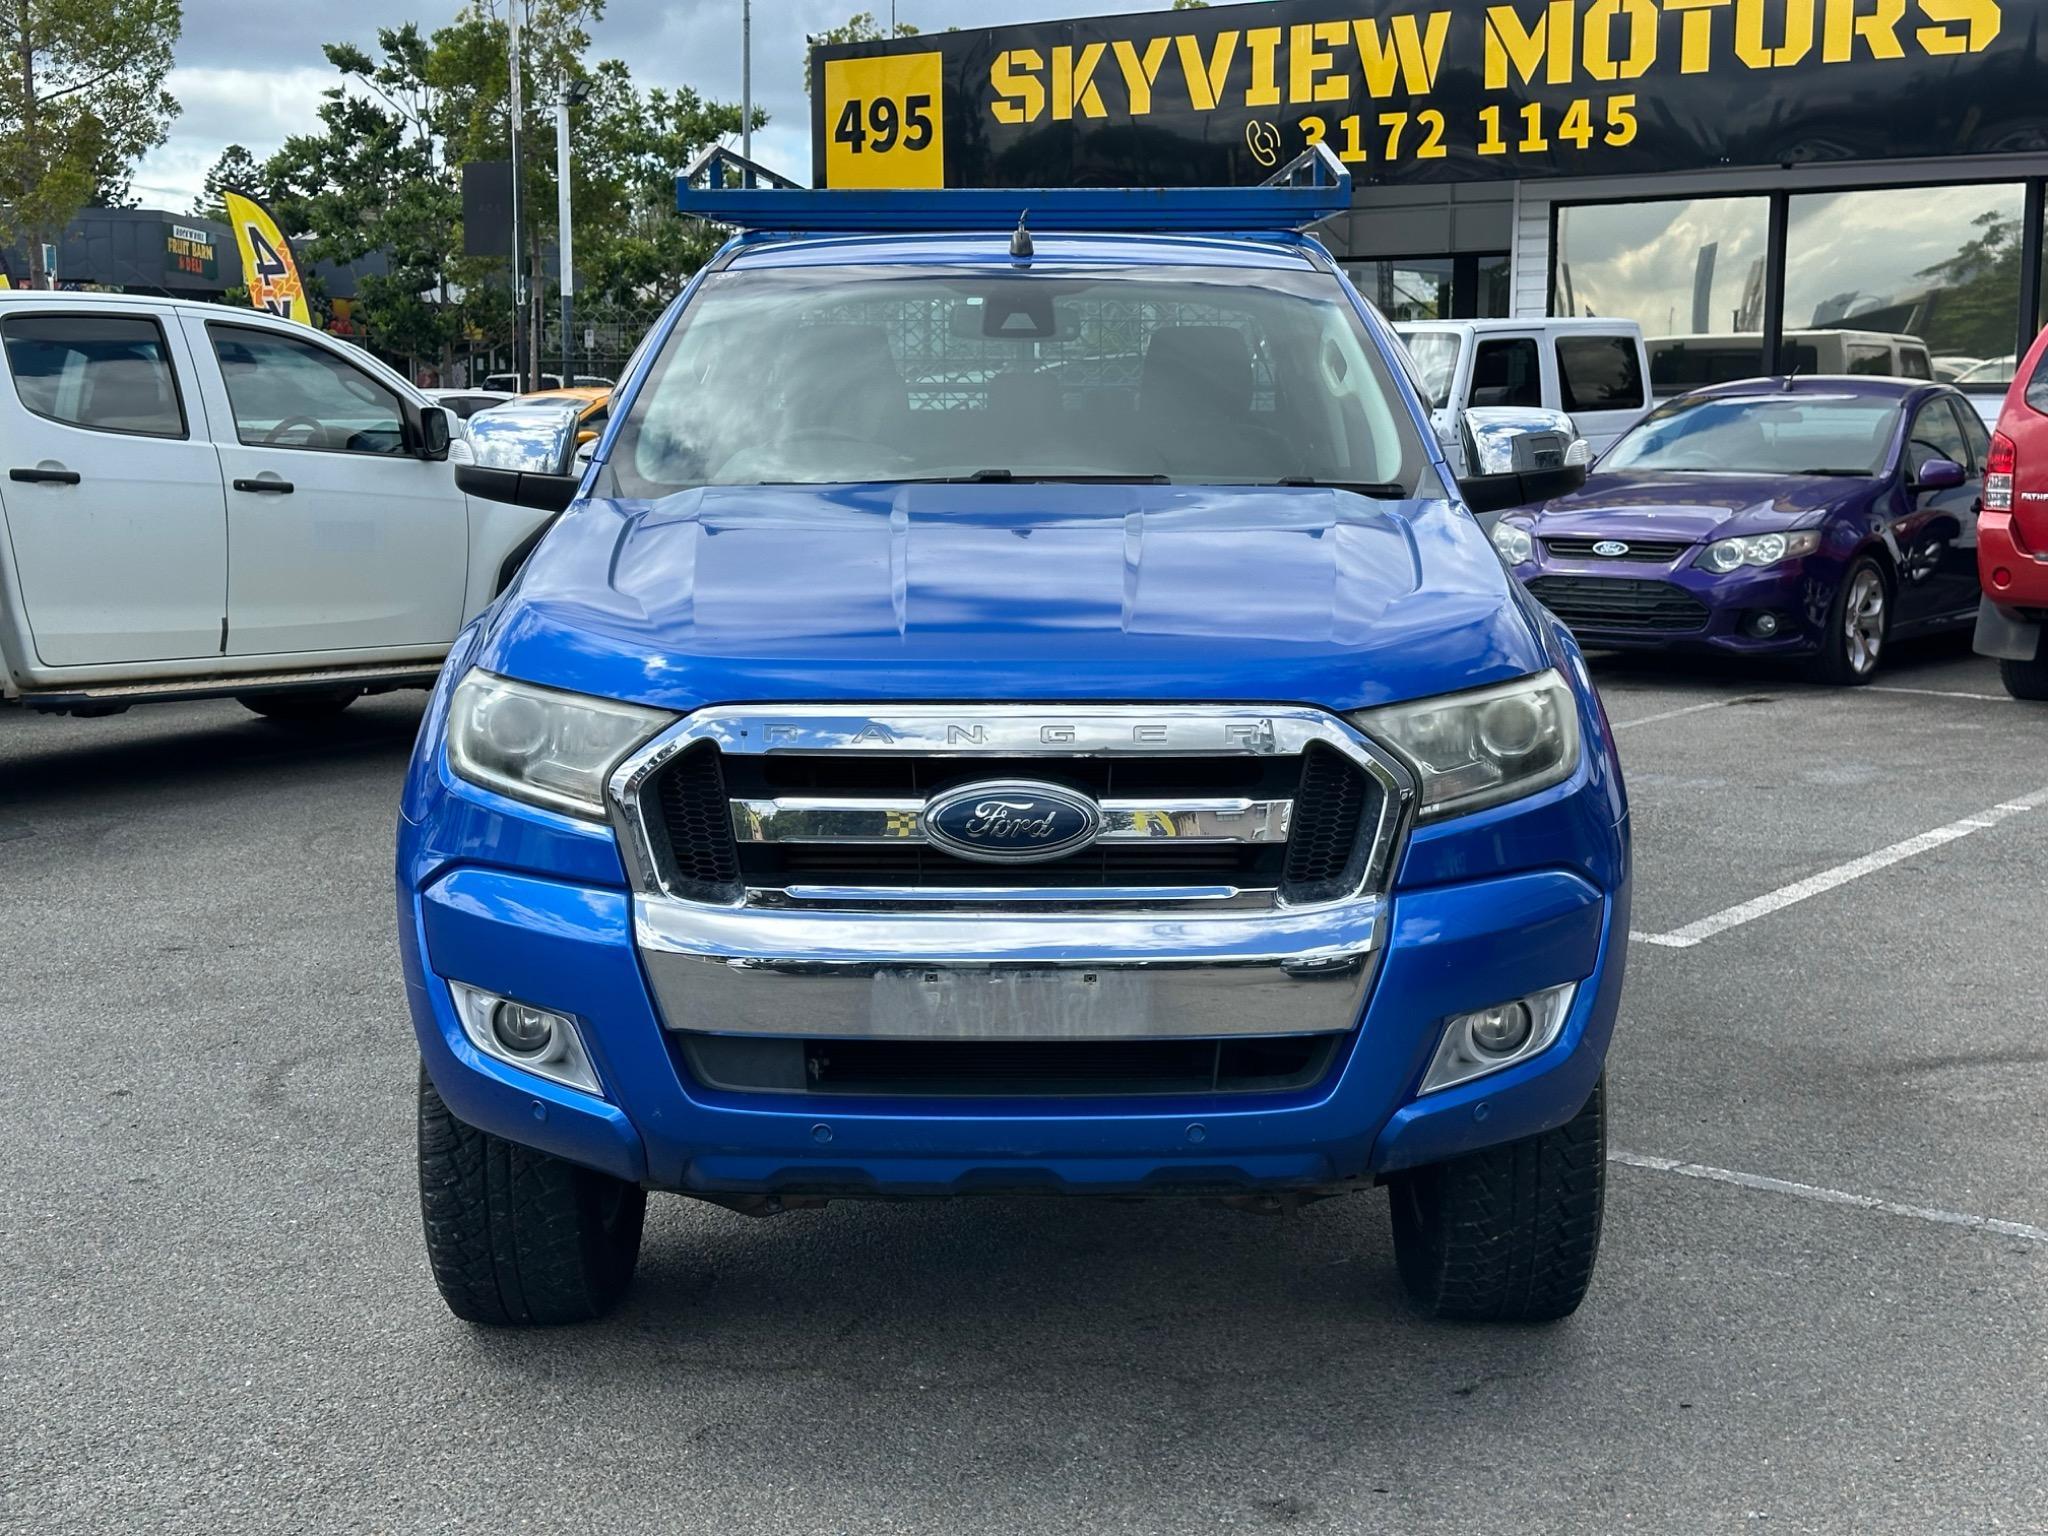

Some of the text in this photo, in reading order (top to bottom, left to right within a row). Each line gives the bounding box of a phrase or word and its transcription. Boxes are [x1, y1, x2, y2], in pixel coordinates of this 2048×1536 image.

[990, 0, 2001, 124] SKYVIEW MOTORS
[834, 94, 933, 154] 495
[1298, 94, 1638, 163] 3172 1145
[168, 236, 213, 261] FRUIT BARN
[763, 723, 1262, 746] RANGER
[965, 800, 1057, 838] Ford
